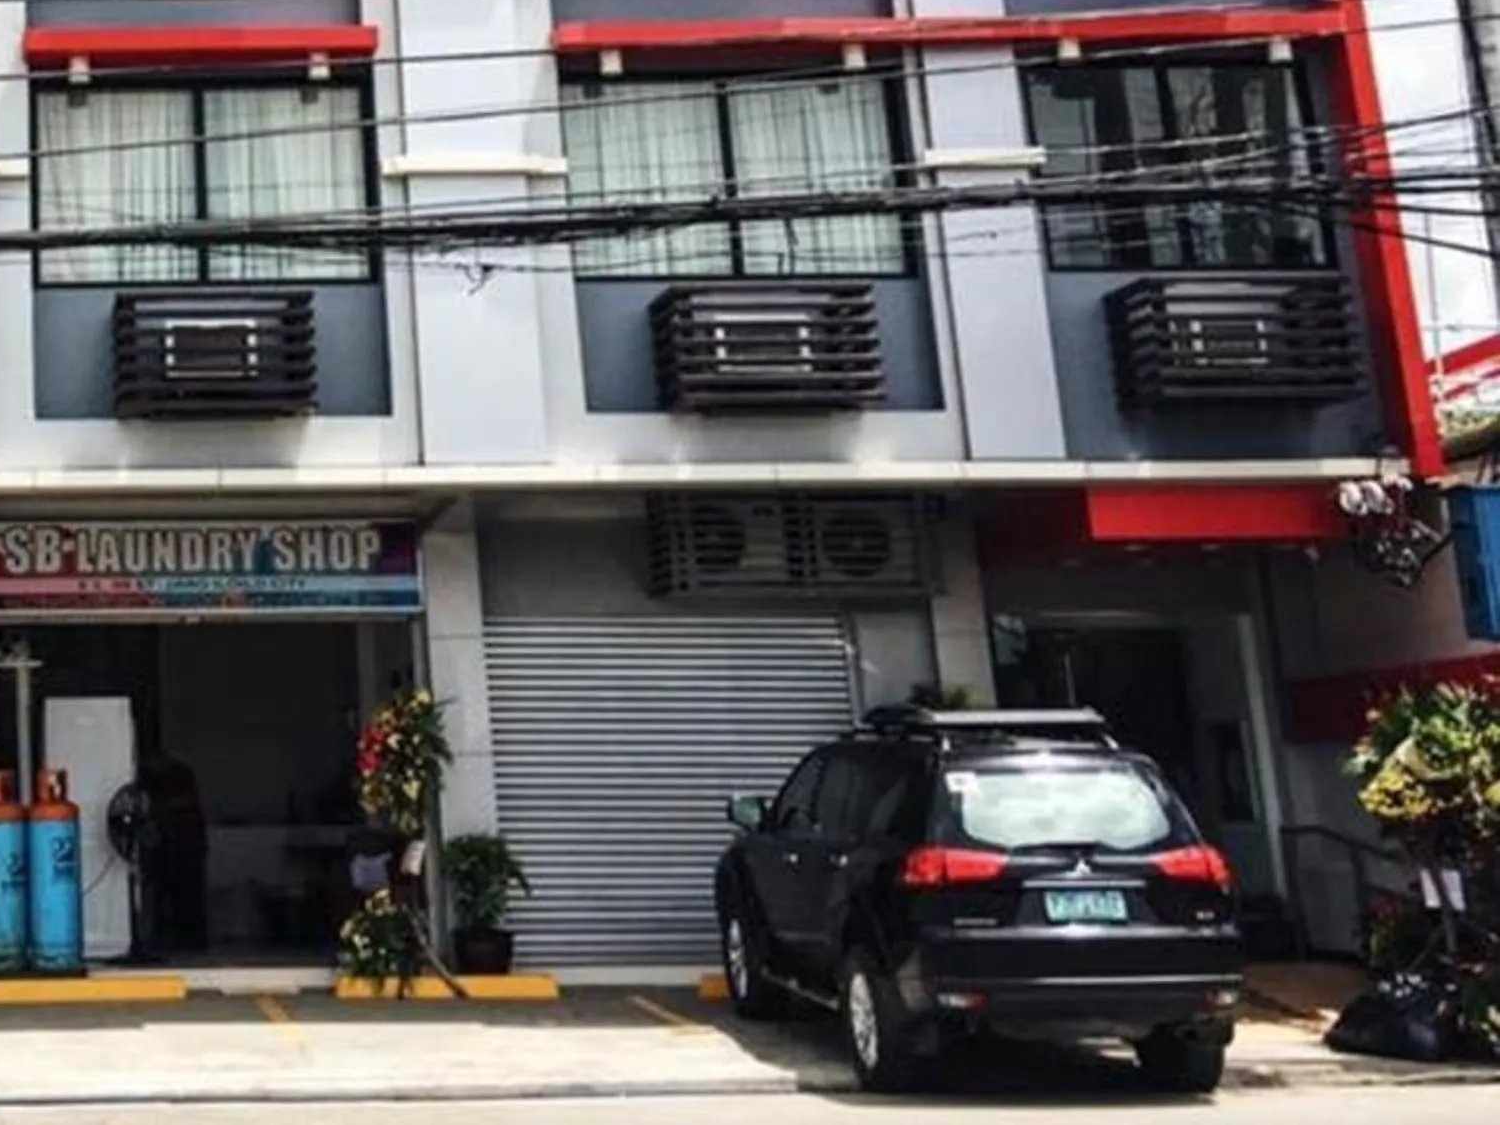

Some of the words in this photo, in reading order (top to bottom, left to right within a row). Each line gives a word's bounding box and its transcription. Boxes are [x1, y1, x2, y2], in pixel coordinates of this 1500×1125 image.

[3, 527, 62, 573] SB
[76, 527, 257, 572] LAUNDRY
[271, 527, 382, 571] SHOP
